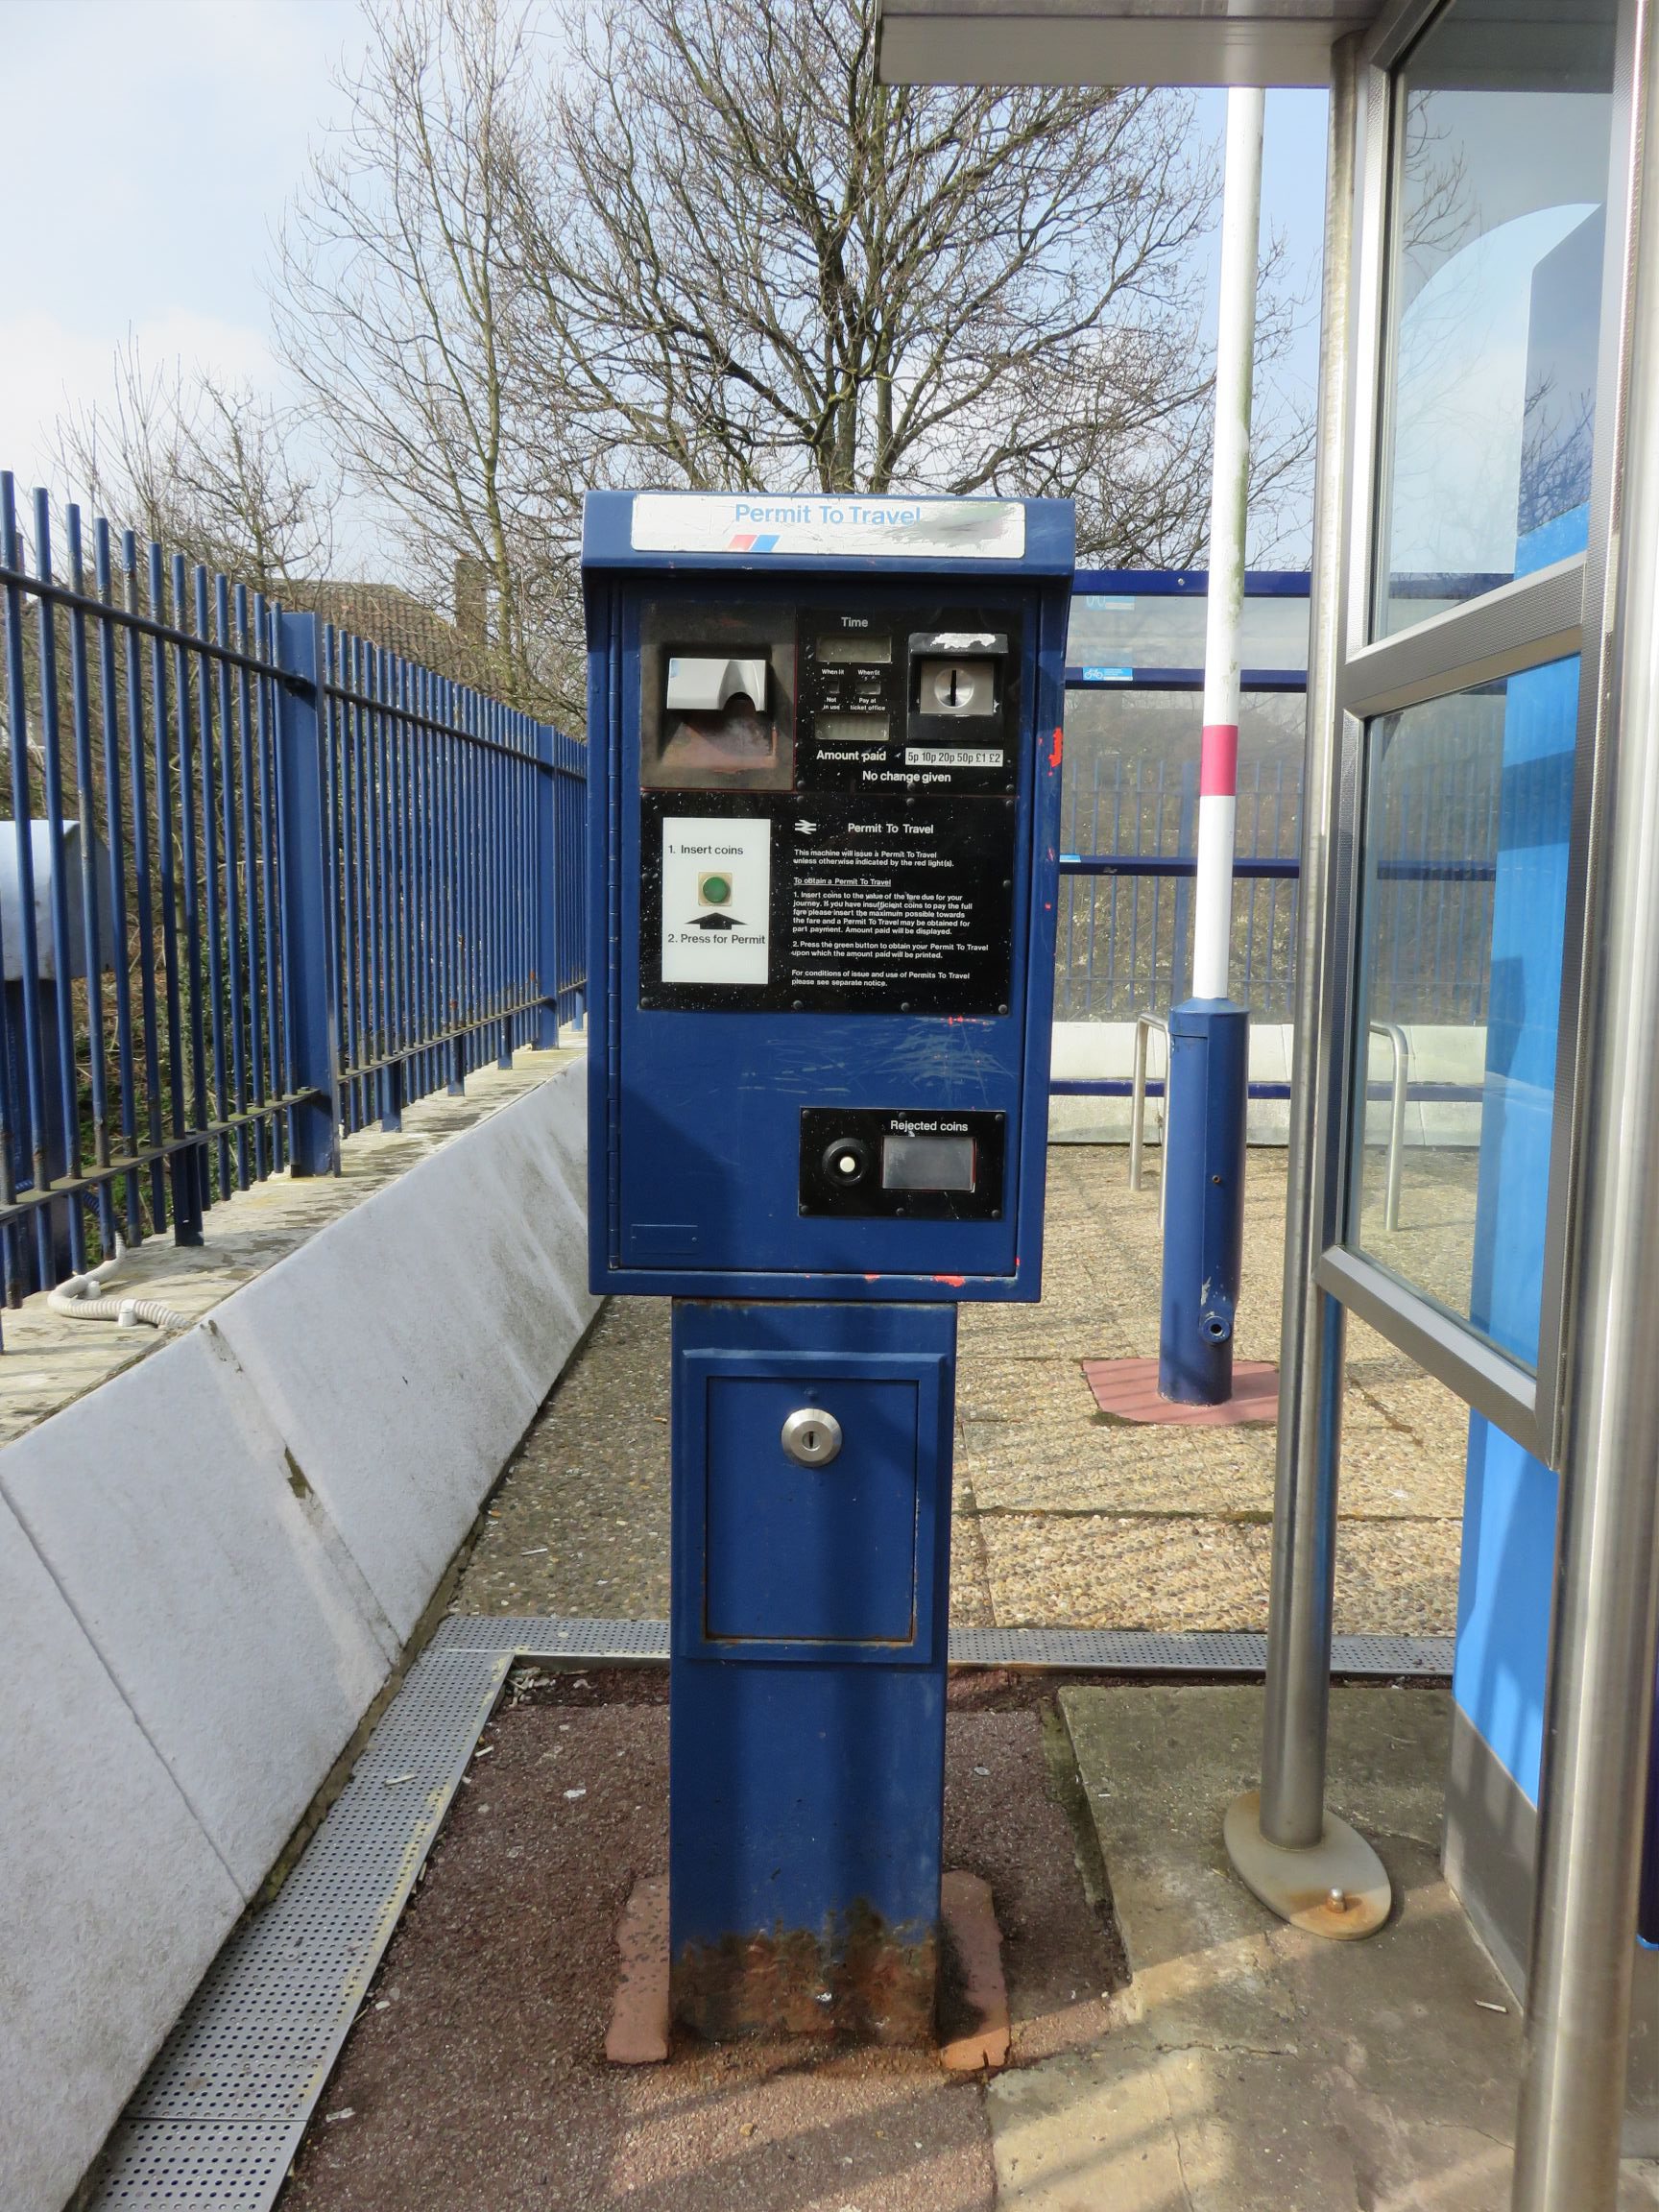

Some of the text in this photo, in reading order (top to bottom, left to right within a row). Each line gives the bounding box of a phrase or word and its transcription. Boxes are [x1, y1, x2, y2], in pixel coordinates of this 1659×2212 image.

[735, 504, 921, 525] Permit To Travel
[841, 617, 869, 627] Time
[816, 750, 886, 762] Amount paid
[908, 753, 1000, 763] 5p 10p 20p 50p £1 £2
[863, 771, 951, 782] No change given
[848, 823, 934, 833] Permit To Travel
[668, 845, 743, 854] 1. Insert coins
[667, 934, 765, 944] 2. Press for Permit
[891, 1120, 968, 1132] Rejected coins
